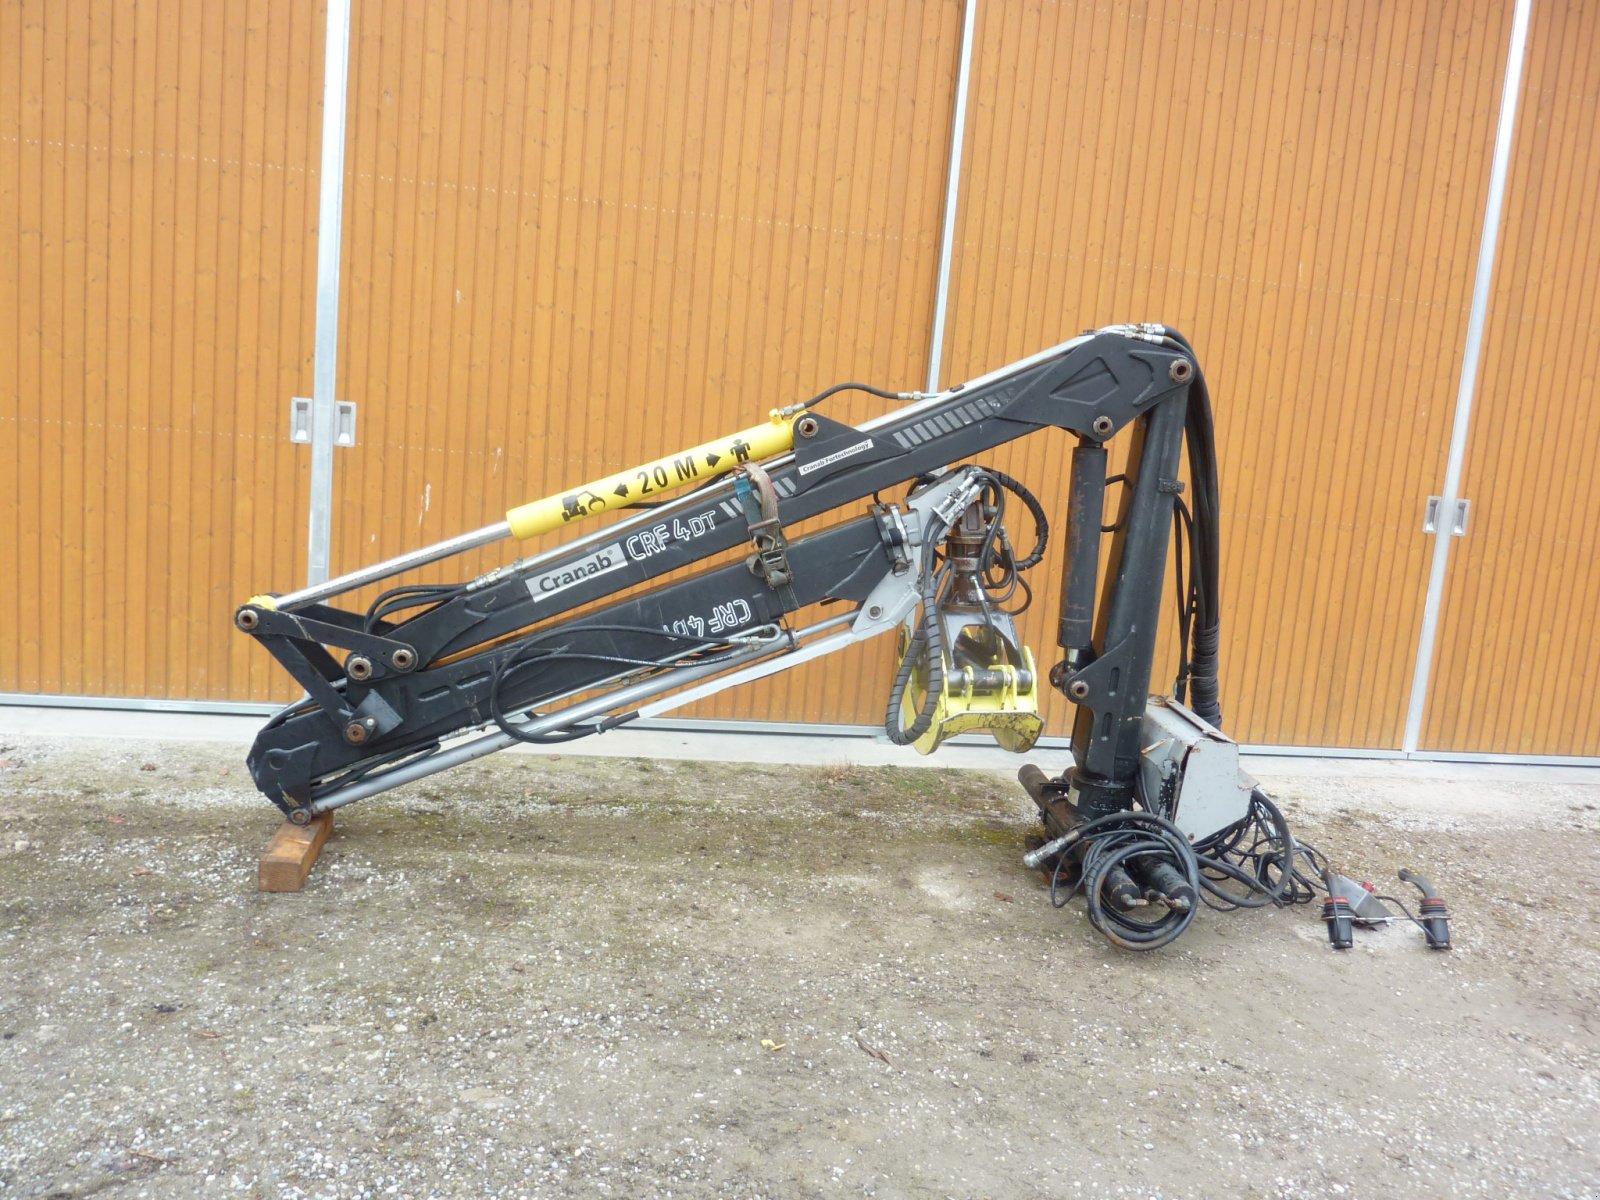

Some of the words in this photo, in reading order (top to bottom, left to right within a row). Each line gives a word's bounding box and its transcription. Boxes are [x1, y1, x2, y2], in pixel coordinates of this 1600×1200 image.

[637, 466, 668, 494] 20
[674, 456, 698, 481] M
[802, 459, 825, 473] Cranab
[825, 442, 869, 464] Fortechnology
[626, 523, 670, 561] CRF
[708, 599, 751, 633] CRF
